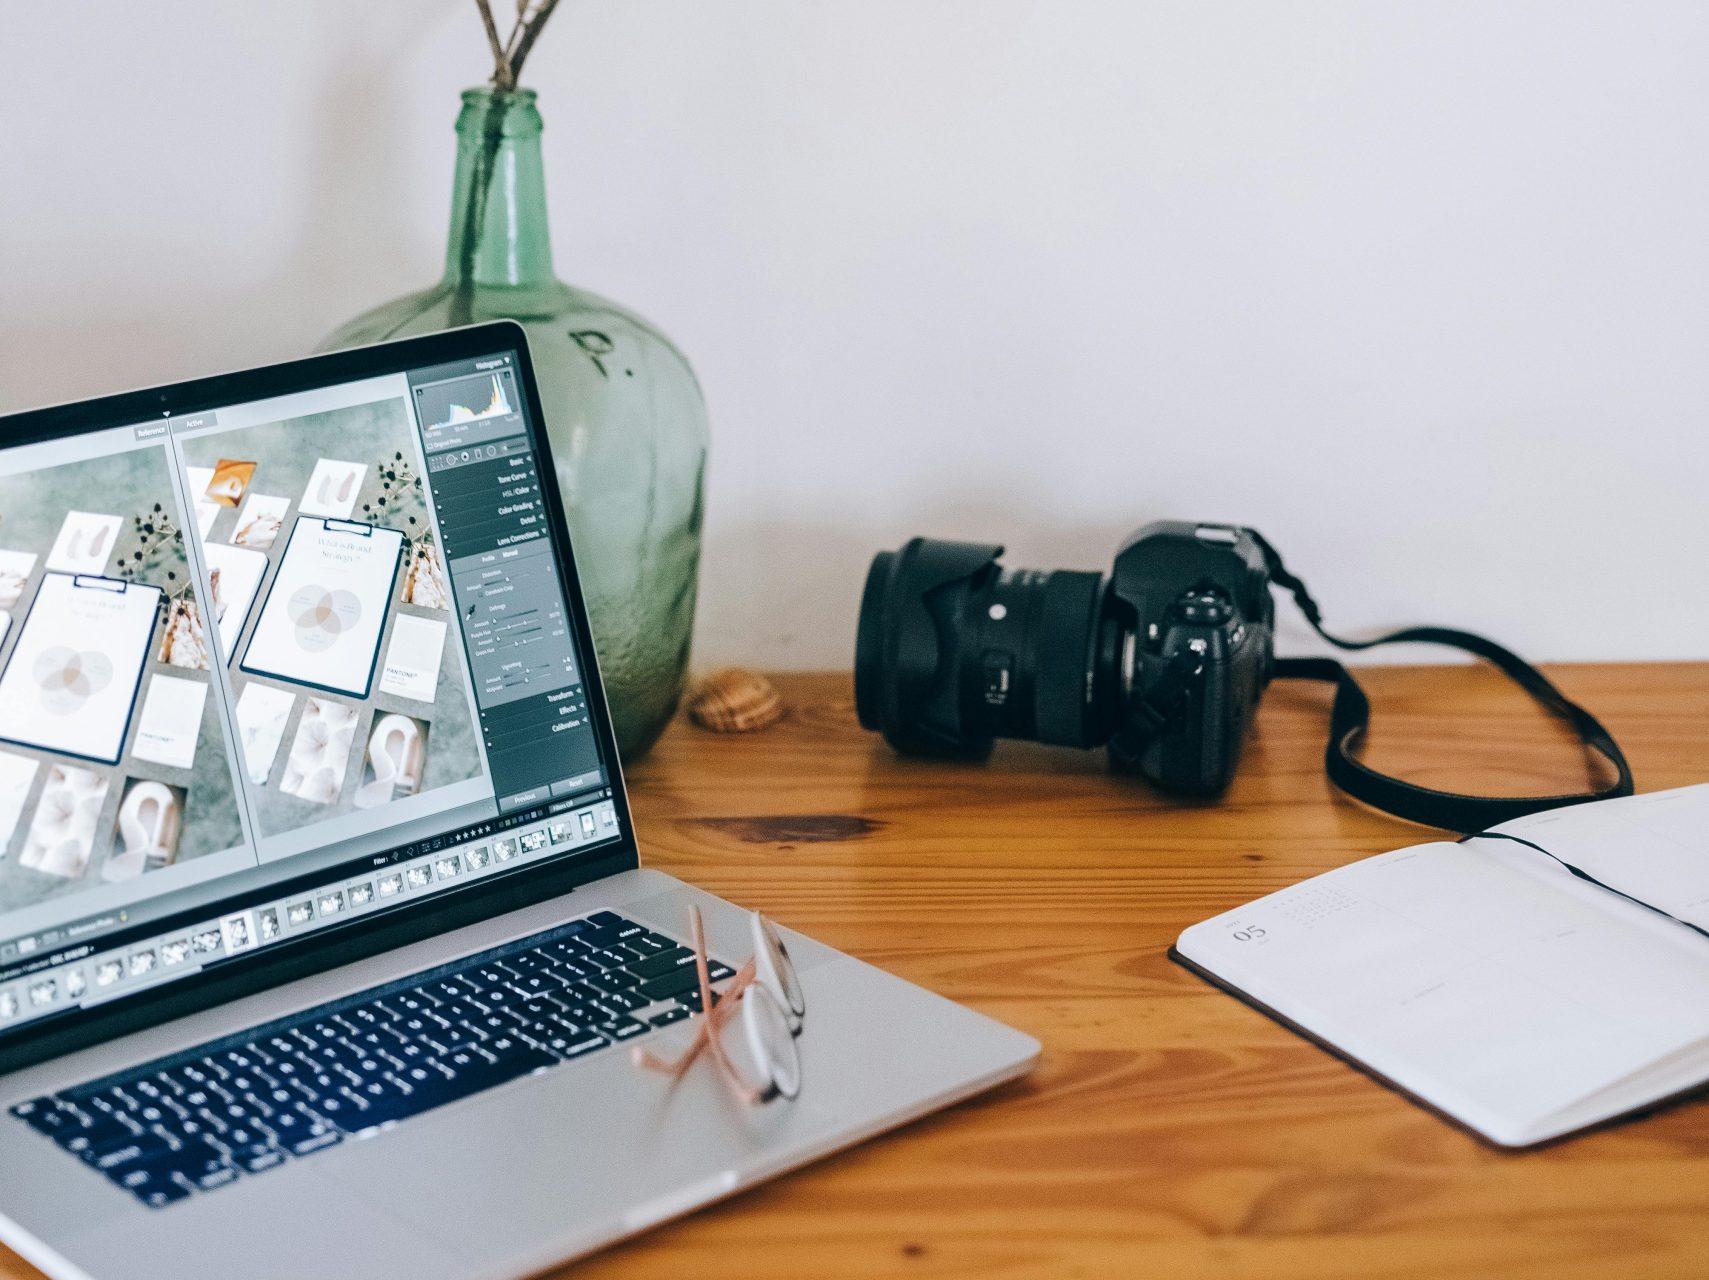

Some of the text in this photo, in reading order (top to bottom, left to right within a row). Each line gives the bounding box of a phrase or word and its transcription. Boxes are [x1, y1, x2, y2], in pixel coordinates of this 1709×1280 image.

[186, 420, 204, 429] Active
[137, 428, 166, 438] Reference
[498, 503, 535, 516] Color Grading
[519, 515, 537, 526] Detail
[497, 531, 540, 546] Lens Corrections
[547, 691, 575, 703] Transform
[558, 705, 578, 716] Effects
[551, 720, 581, 733] Calibration
[514, 793, 537, 805] Previous
[1232, 924, 1267, 943] 05
